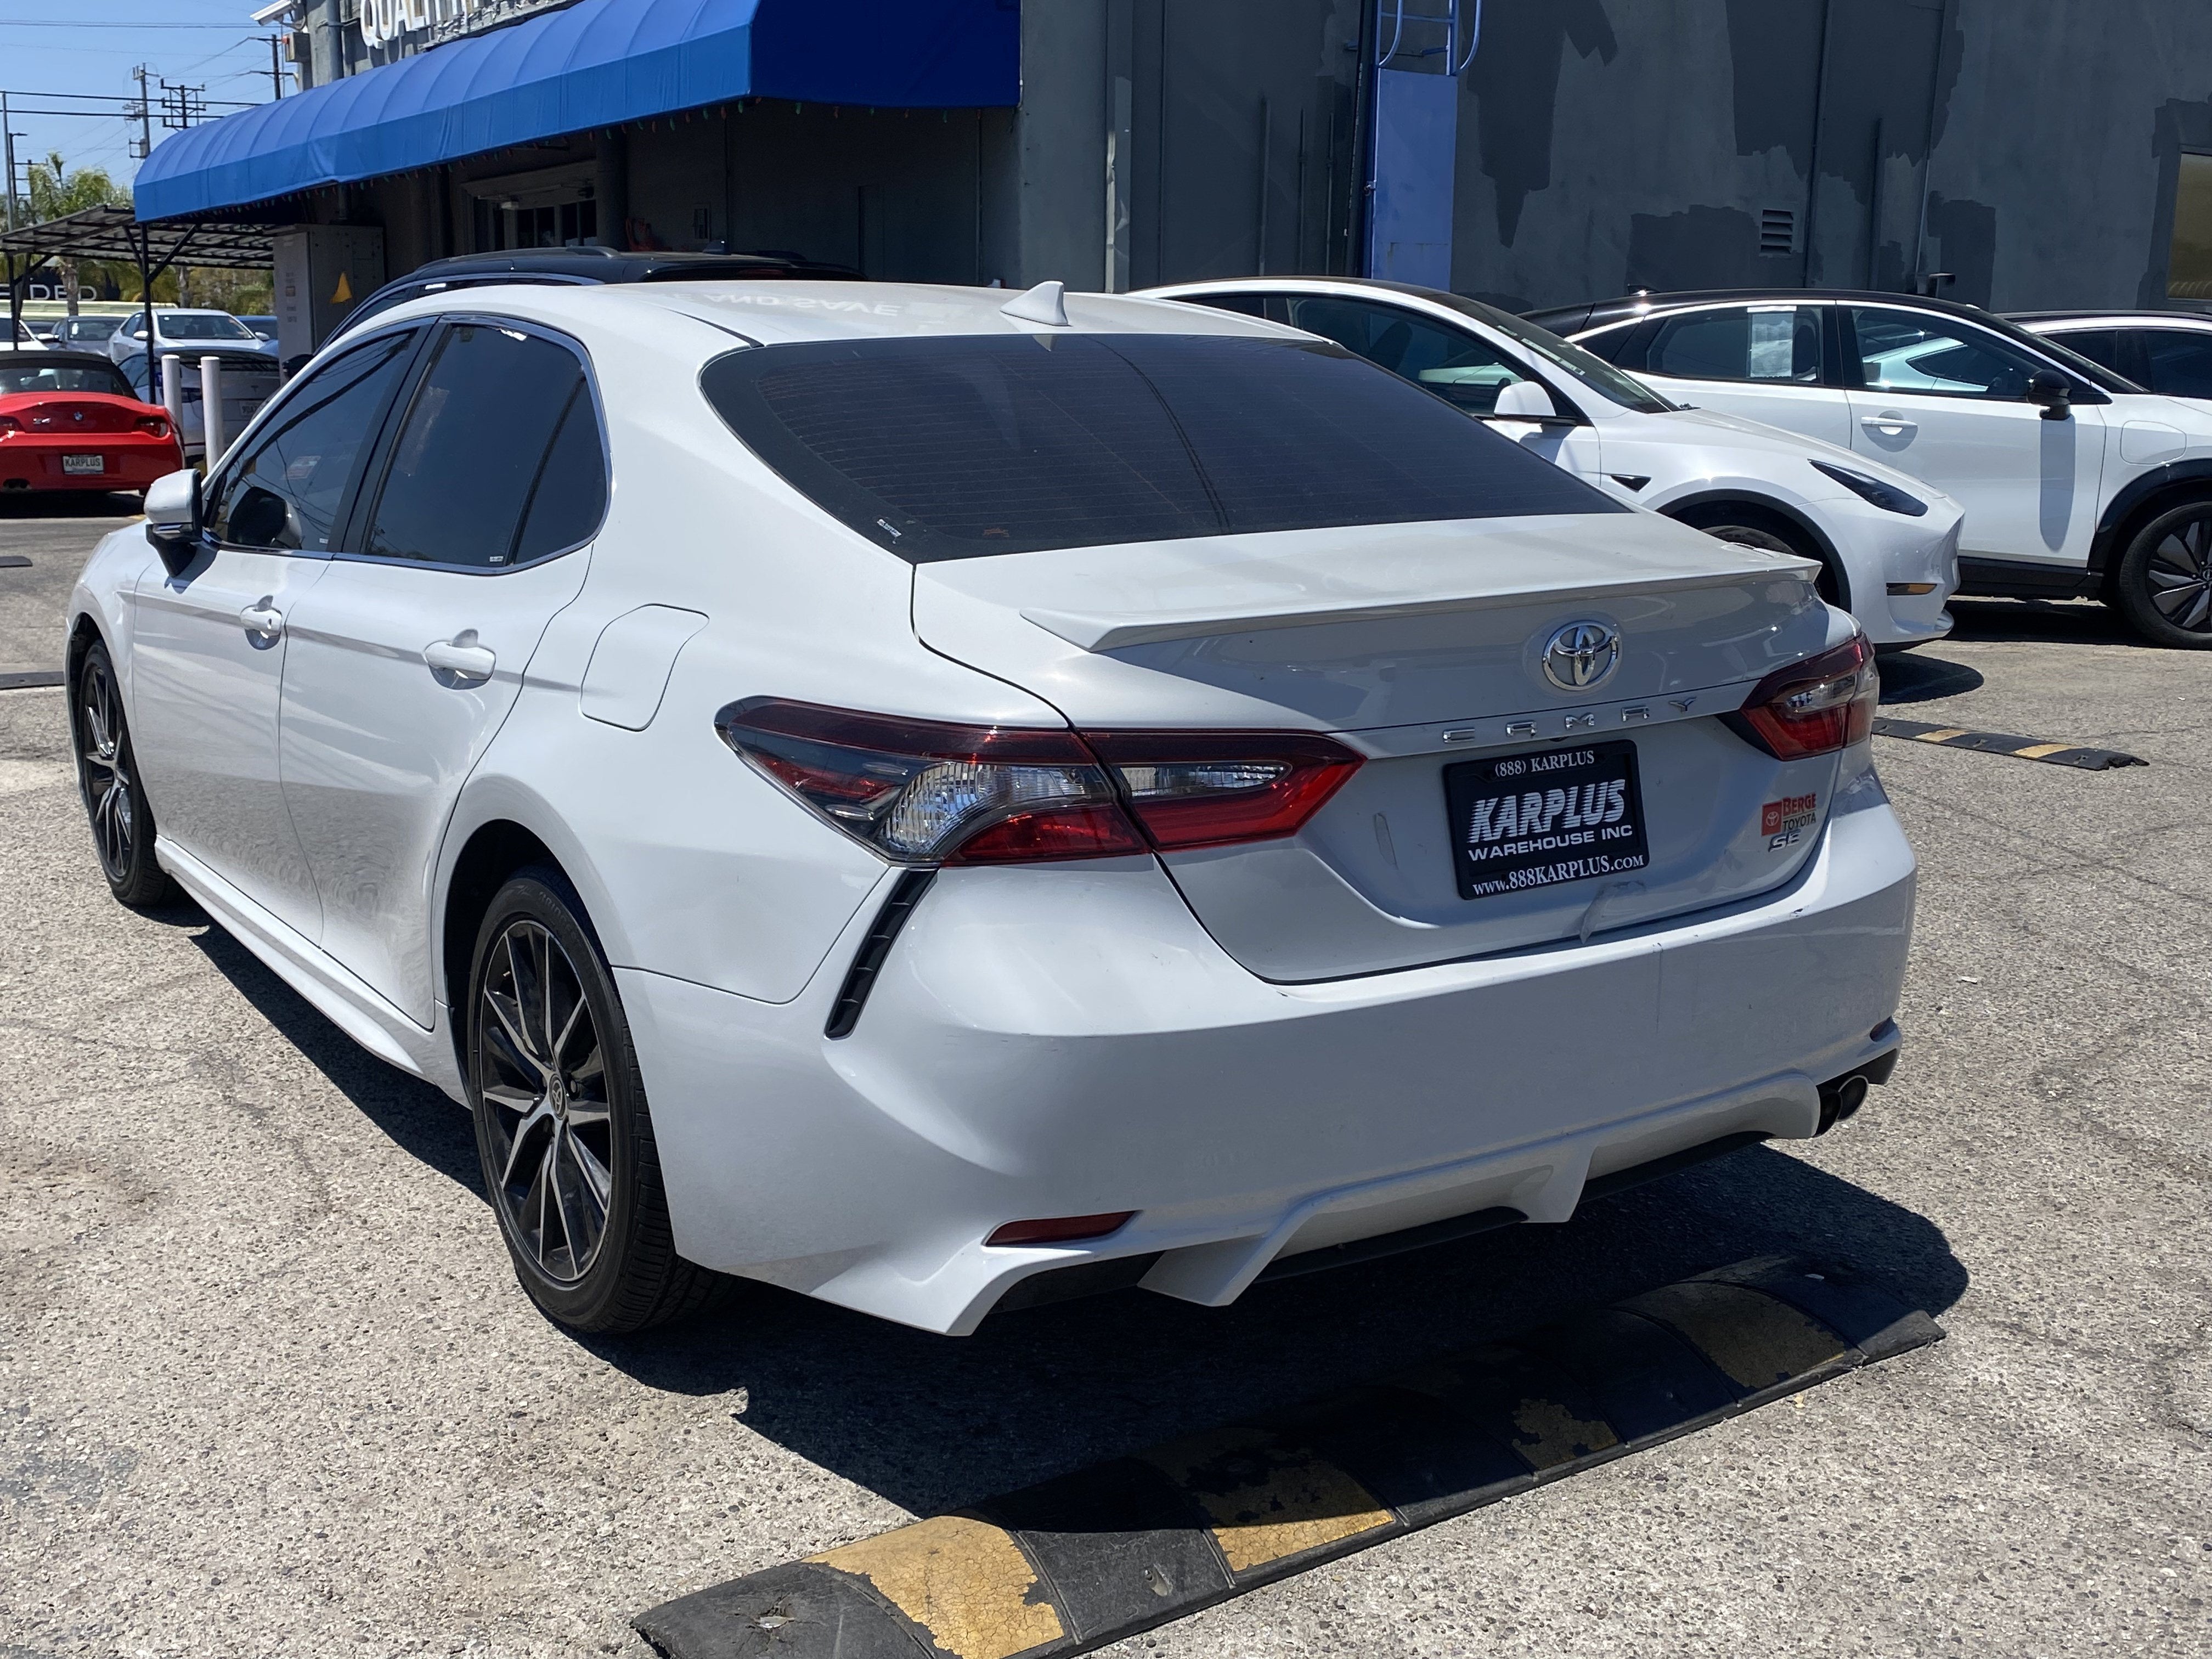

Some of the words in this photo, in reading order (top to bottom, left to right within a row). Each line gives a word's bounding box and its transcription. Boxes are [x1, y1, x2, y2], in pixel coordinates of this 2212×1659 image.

[65, 458, 100, 467] KARPLUS
[1443, 696, 1697, 744] CAMRY
[1495, 759, 1527, 777] (888)
[1530, 750, 1595, 772] KARPLUS
[1467, 778, 1626, 843] KARPLUS
[1781, 792, 1817, 817] BERGE
[1782, 811, 1817, 832] TOYOTA
[1468, 831, 1595, 862] WAREHOUSE
[1601, 825, 1633, 840] INC
[1768, 829, 1802, 853] SE
